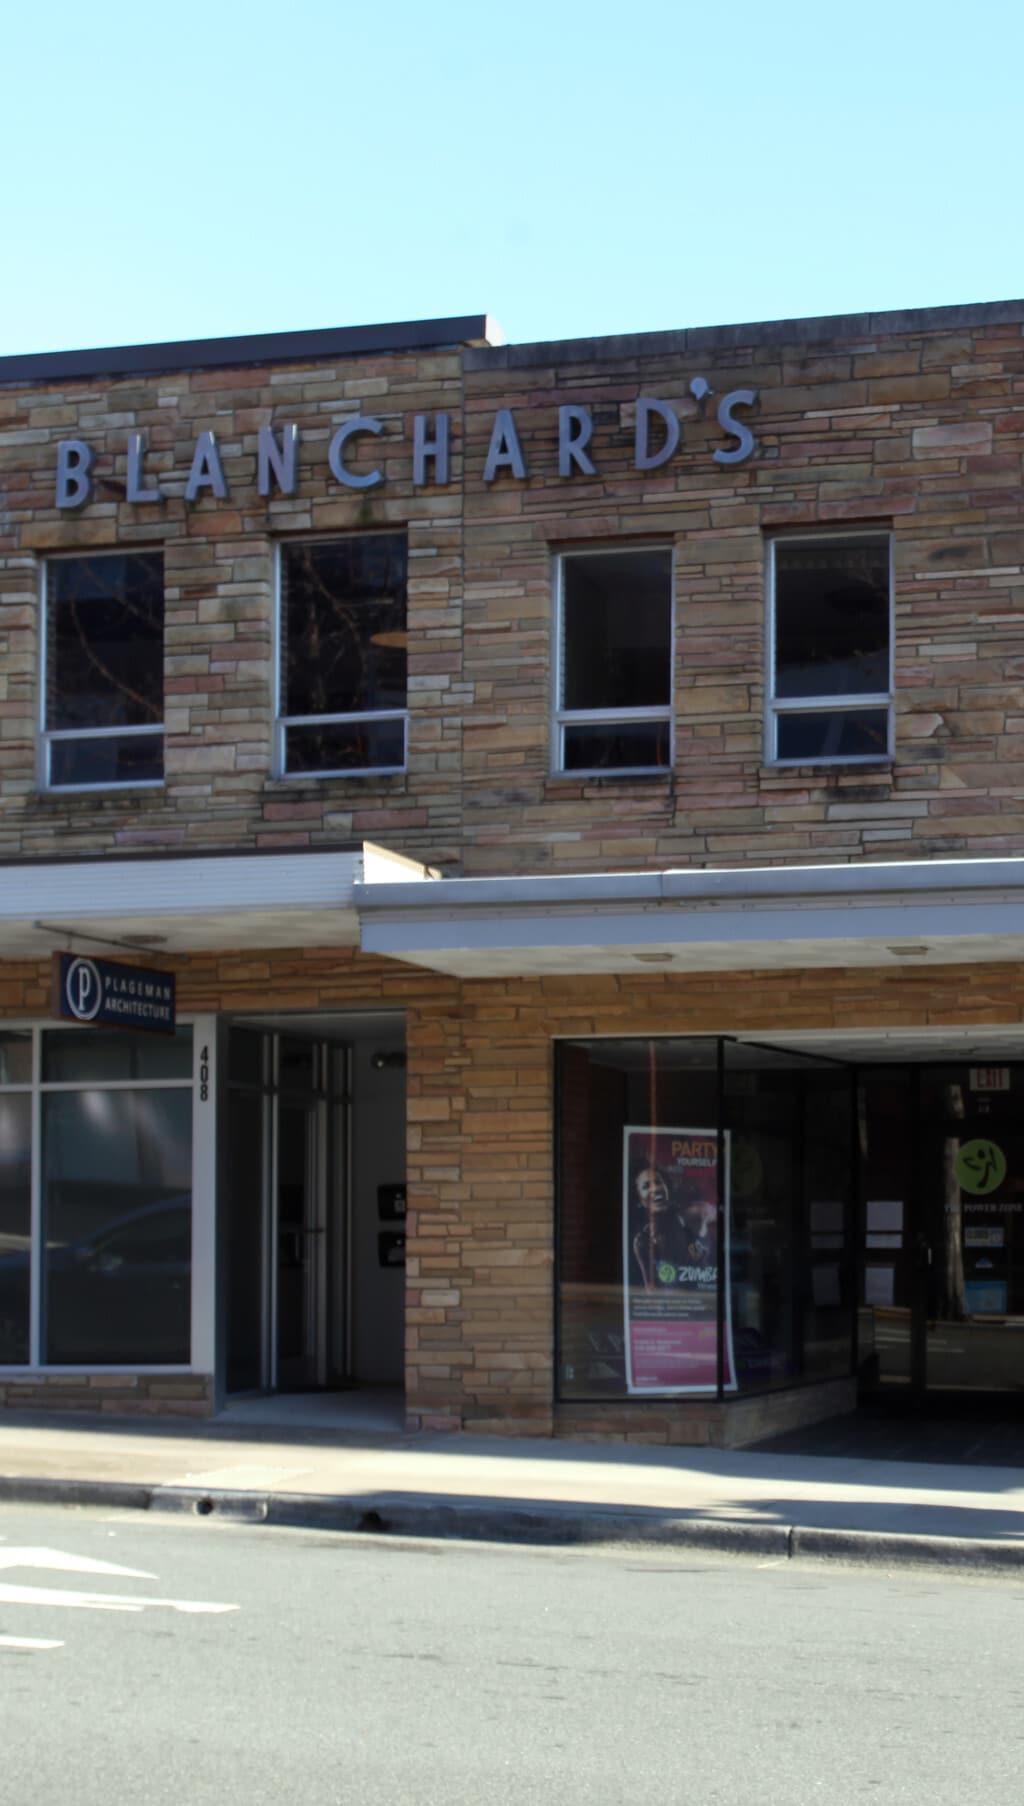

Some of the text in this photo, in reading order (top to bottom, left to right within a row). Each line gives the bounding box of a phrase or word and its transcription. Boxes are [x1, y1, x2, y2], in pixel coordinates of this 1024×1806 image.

[55, 376, 758, 509] BLANCHARD'S
[104, 975, 171, 1001] PLAGEMAN
[104, 997, 170, 1021] ARCHITECTURE
[200, 1045, 209, 1101] 408
[977, 1068, 1005, 1088] EXIT
